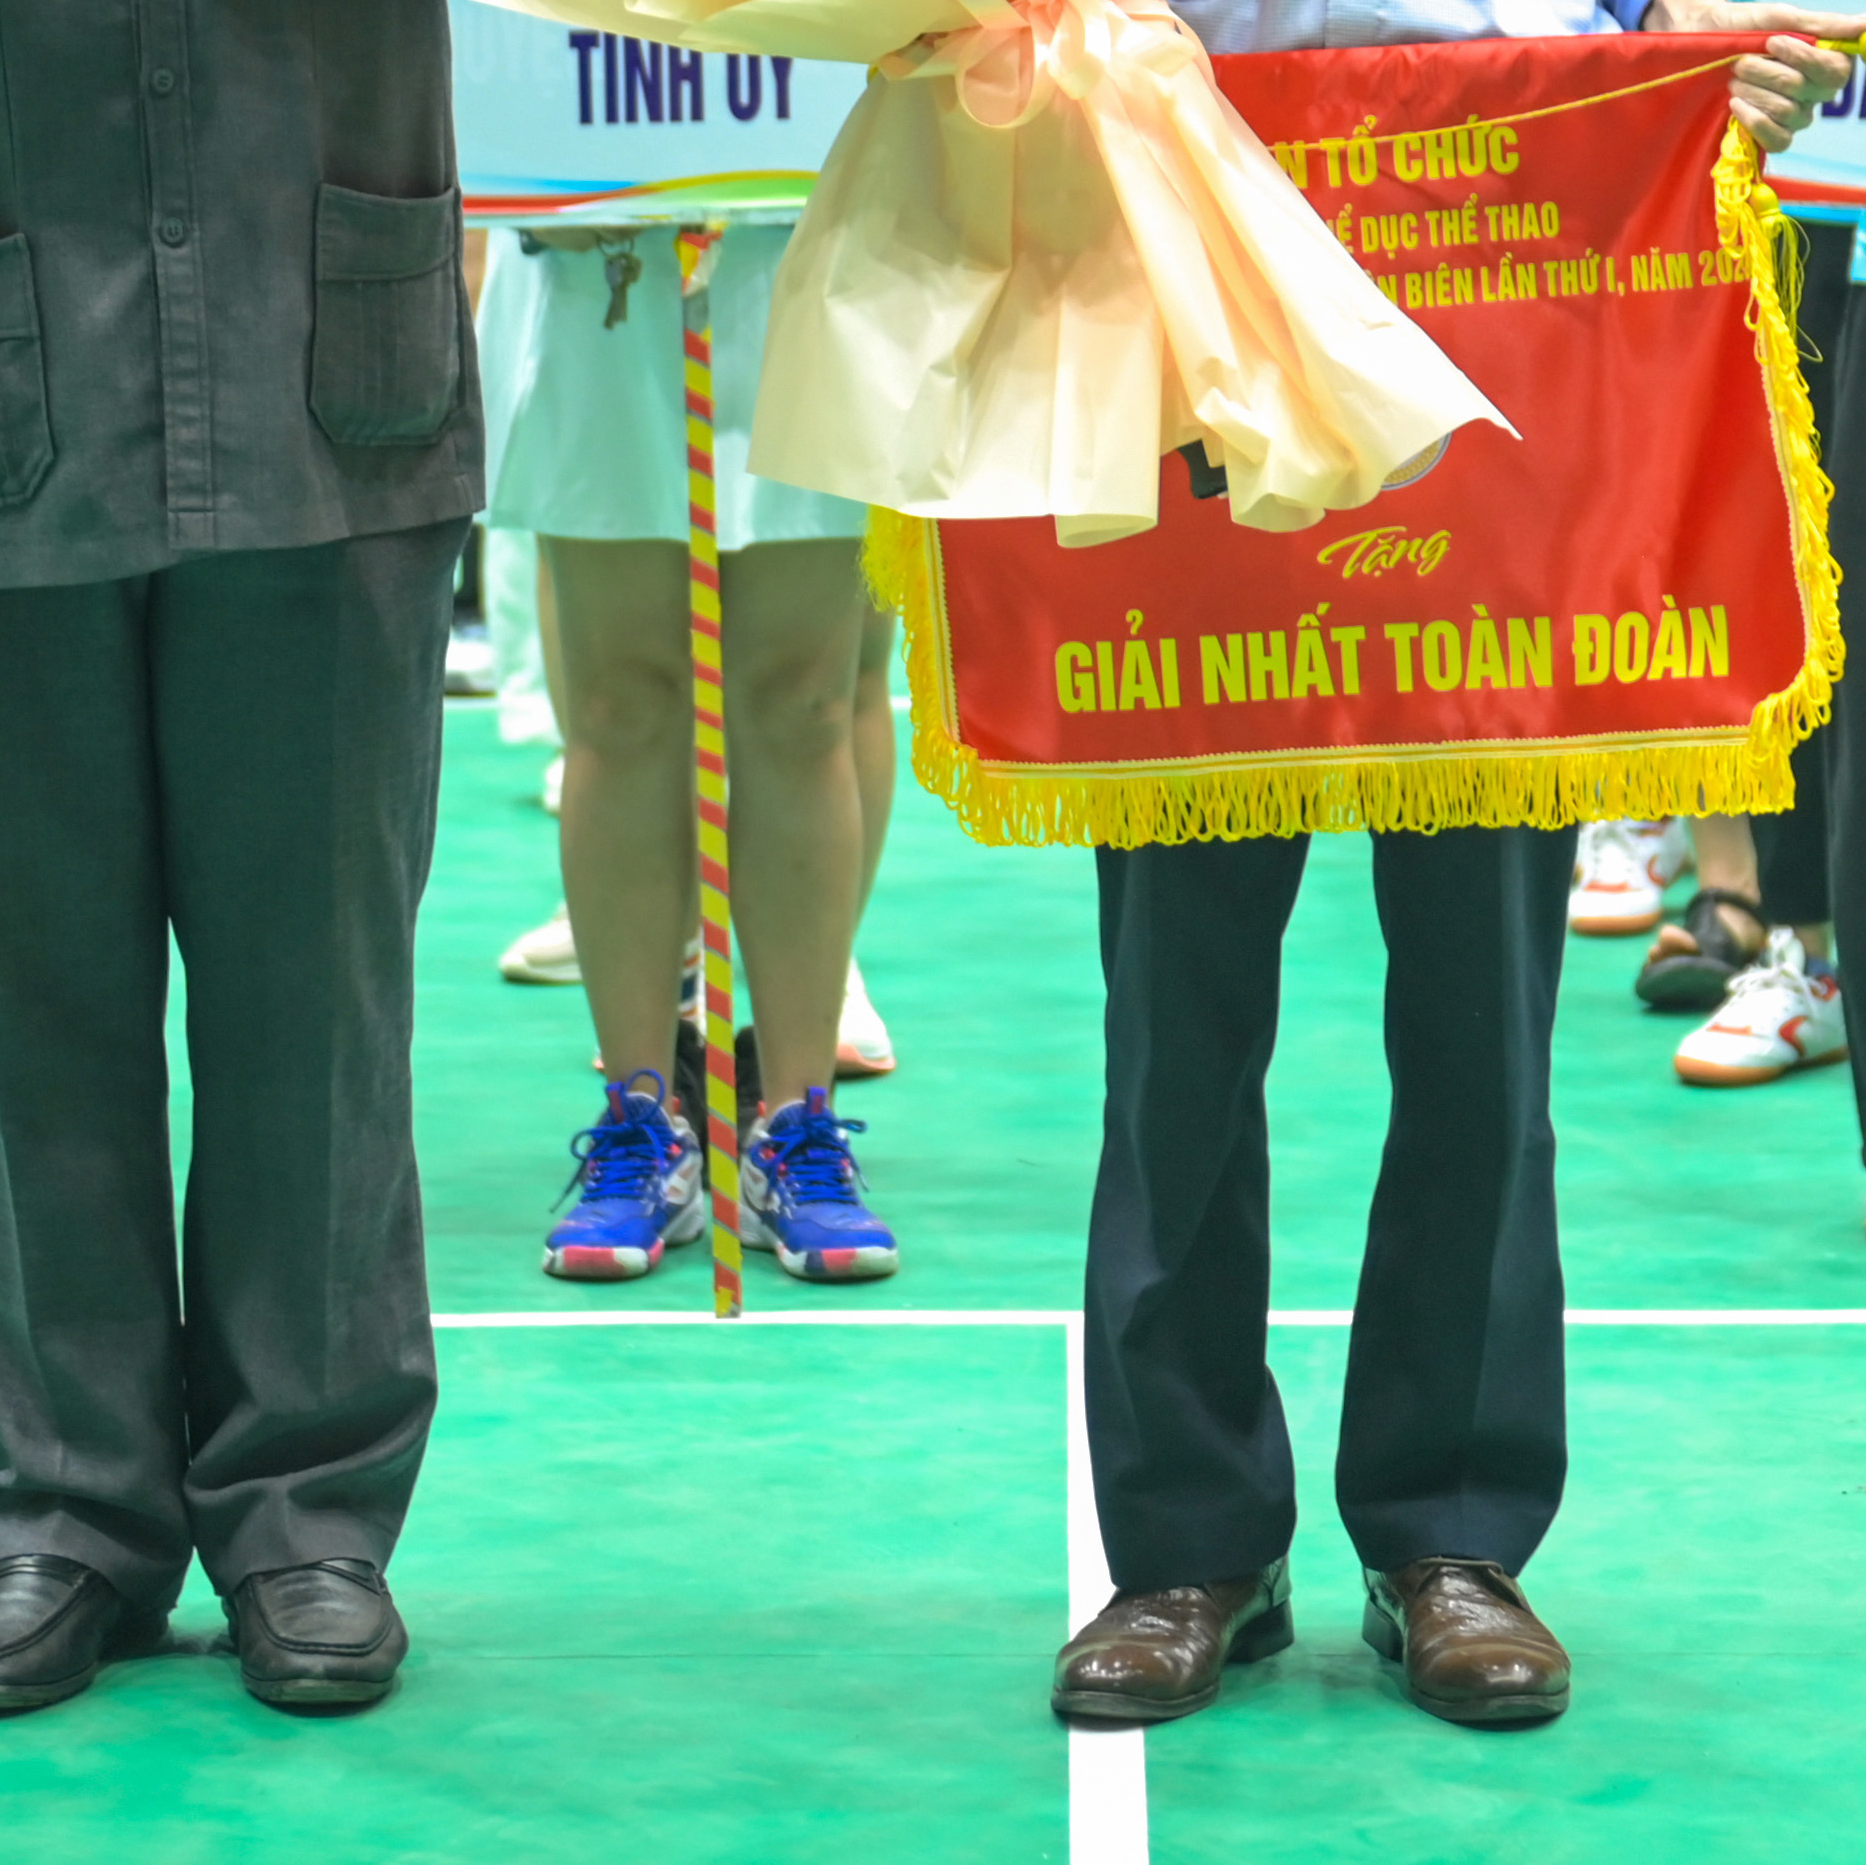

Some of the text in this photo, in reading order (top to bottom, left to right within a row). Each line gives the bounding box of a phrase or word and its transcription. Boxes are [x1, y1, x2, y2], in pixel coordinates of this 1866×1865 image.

[1320, 115, 1377, 187] TỔ
[1393, 114, 1520, 183] CHỨC
[1361, 211, 1419, 260] DỤC
[1426, 193, 1479, 245] THỂ
[1486, 201, 1560, 242] THAO
[1405, 262, 1474, 310] BIÊN
[1481, 250, 1538, 302] LẦN
[1544, 248, 1602, 296] THỨ
[1631, 247, 1693, 292] NĂM
[1317, 526, 1452, 578] Tặng
[1055, 594, 1730, 713] GIẢI NHẤT TOÀN ĐOÀN
